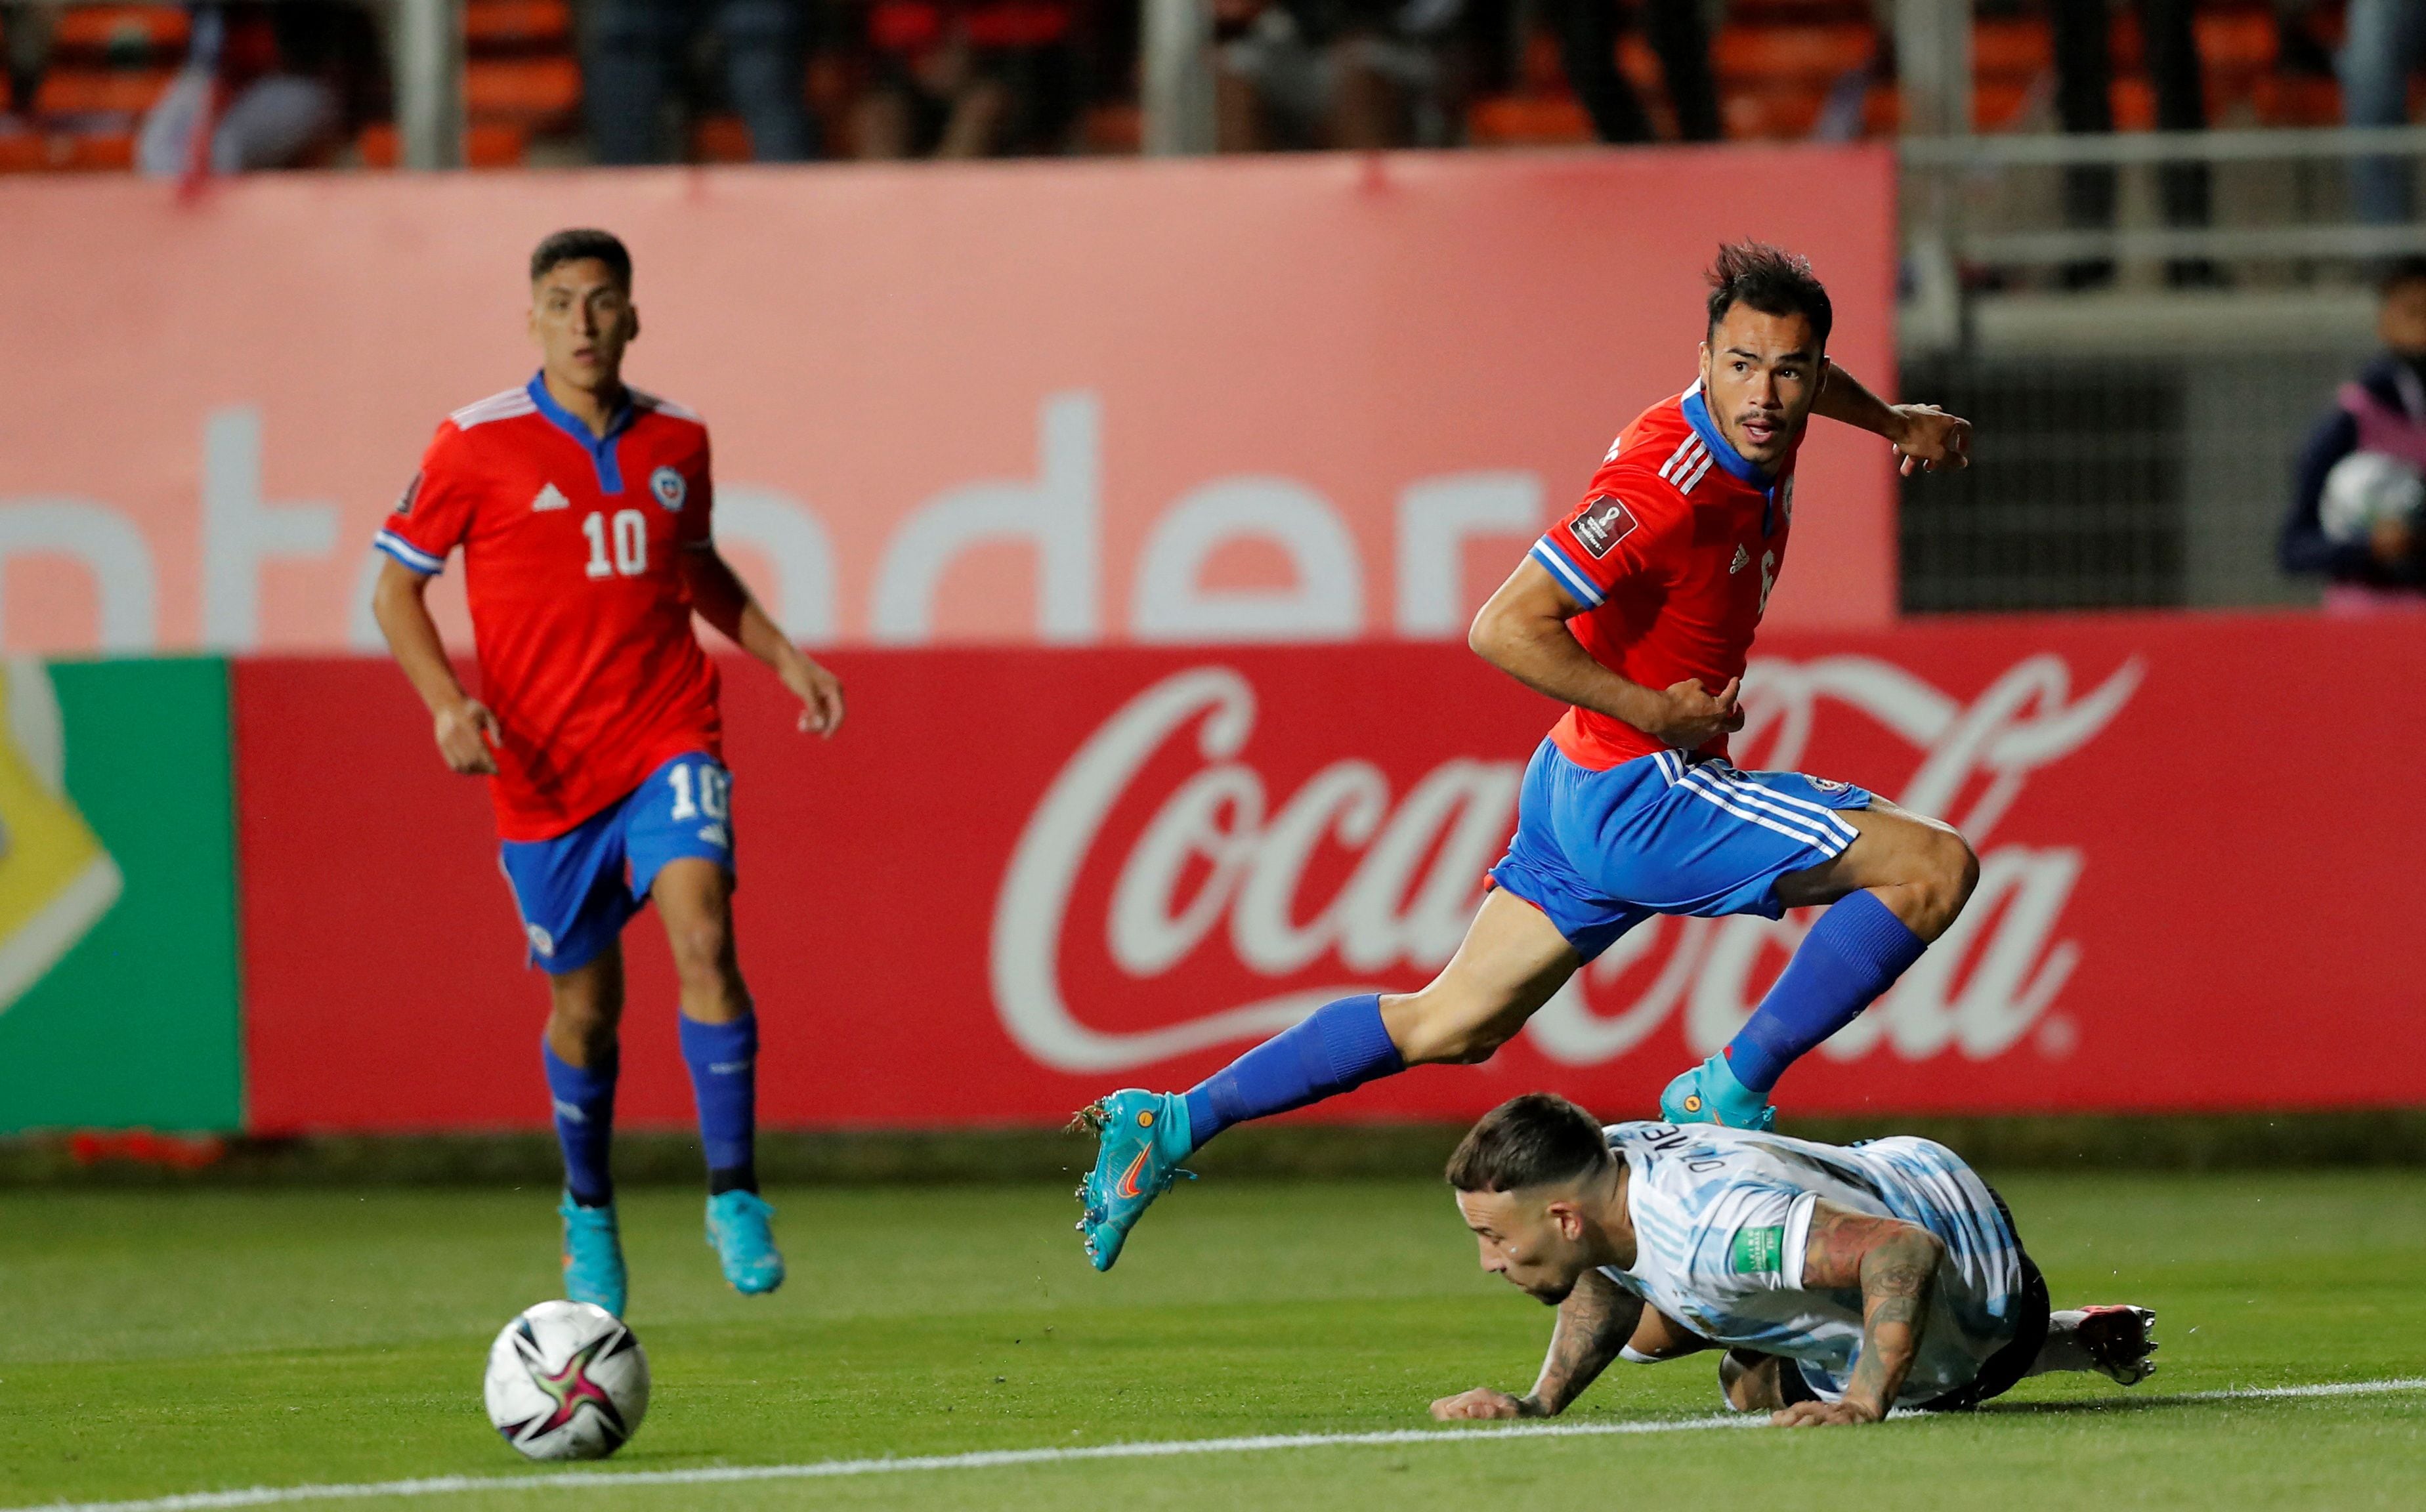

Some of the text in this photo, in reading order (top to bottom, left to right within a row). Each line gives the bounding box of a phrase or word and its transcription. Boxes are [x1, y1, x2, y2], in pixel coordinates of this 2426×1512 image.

[582, 509, 647, 578] 10
[668, 763, 727, 821] 10
[989, 652, 2146, 1076] CocaCola
